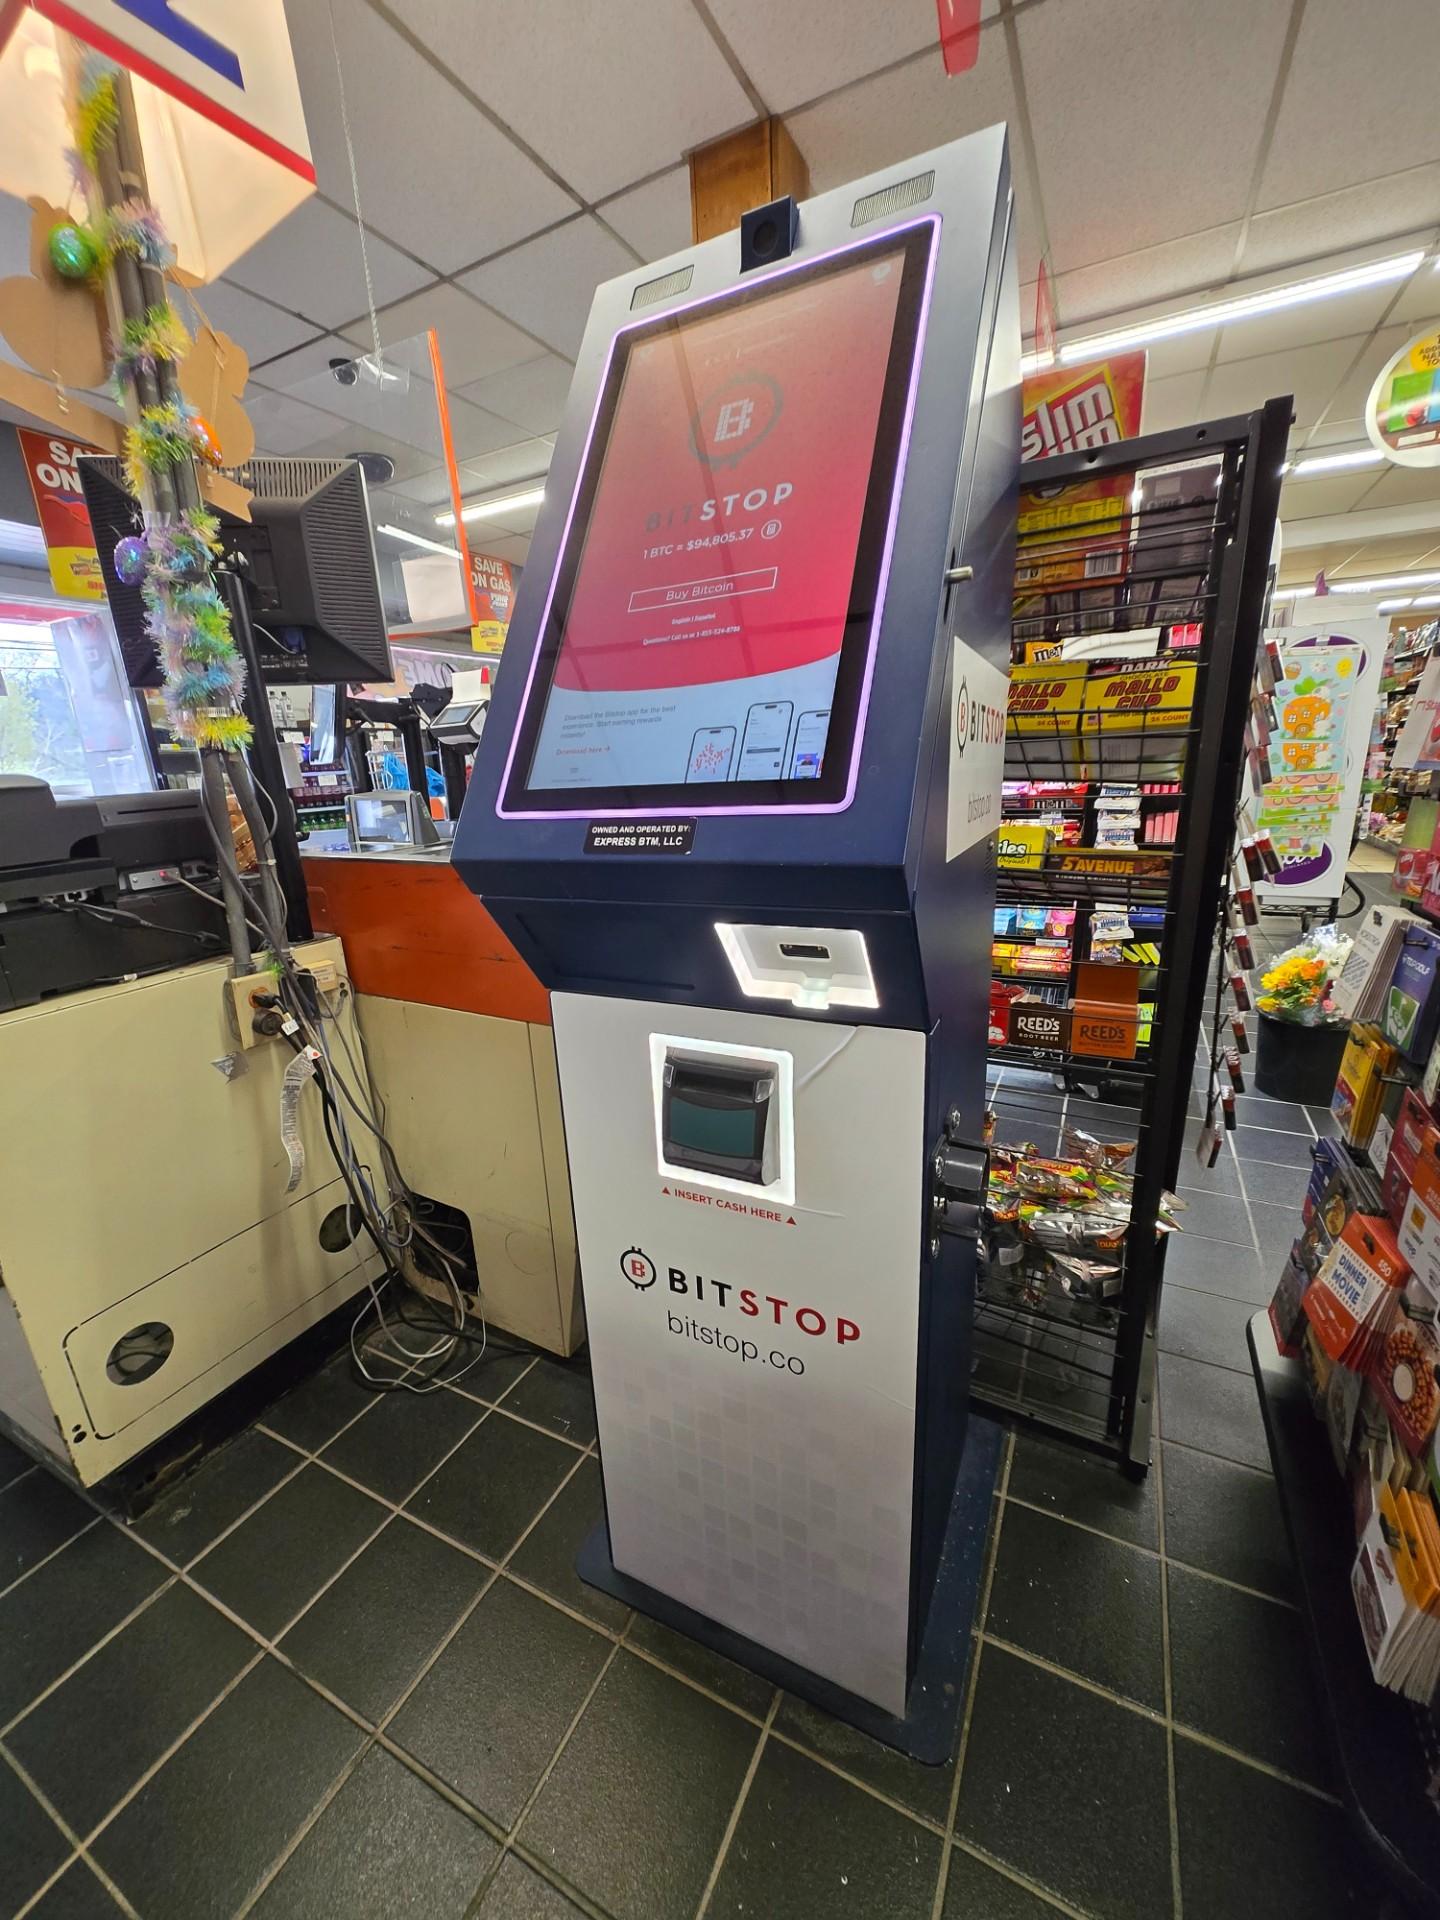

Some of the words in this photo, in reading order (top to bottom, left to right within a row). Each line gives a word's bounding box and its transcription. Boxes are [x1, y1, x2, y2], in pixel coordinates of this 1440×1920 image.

[645, 482, 793, 533] BITSTOP
[650, 544, 673, 559] BTC
[686, 528, 754, 552] $94,805.37
[474, 557, 503, 577] SAVE
[490, 576, 511, 593] GAS
[666, 589, 688, 601] Buy
[692, 581, 734, 597] Bitcoin
[1120, 659, 1173, 673] DARK
[1120, 671, 1169, 680] CHOCOLATE
[1103, 676, 1181, 698] MALLO
[1007, 699, 1050, 711] CUP
[1115, 693, 1163, 709] CUP
[970, 701, 1004, 745] BITSTOP
[592, 825, 618, 834] OWNED
[618, 825, 635, 833] AND
[636, 825, 675, 833] OPERATED
[676, 825, 690, 833] BY:
[593, 837, 636, 847] EXPRESS
[638, 837, 661, 847] BTM,
[663, 836, 683, 846] LLC
[1075, 857, 1136, 874] AVENUE
[1017, 1016, 1060, 1032] REED'S
[1080, 1024, 1126, 1041] REED'S
[674, 1188, 713, 1206] INSERT
[716, 1199, 747, 1214] CASH
[750, 1207, 782, 1223] HERE
[1339, 1254, 1368, 1289] DINNER
[1332, 1268, 1361, 1305] MOVIE
[668, 1266, 861, 1345] BITSTOP
[667, 1310, 805, 1376] bitstop.co
